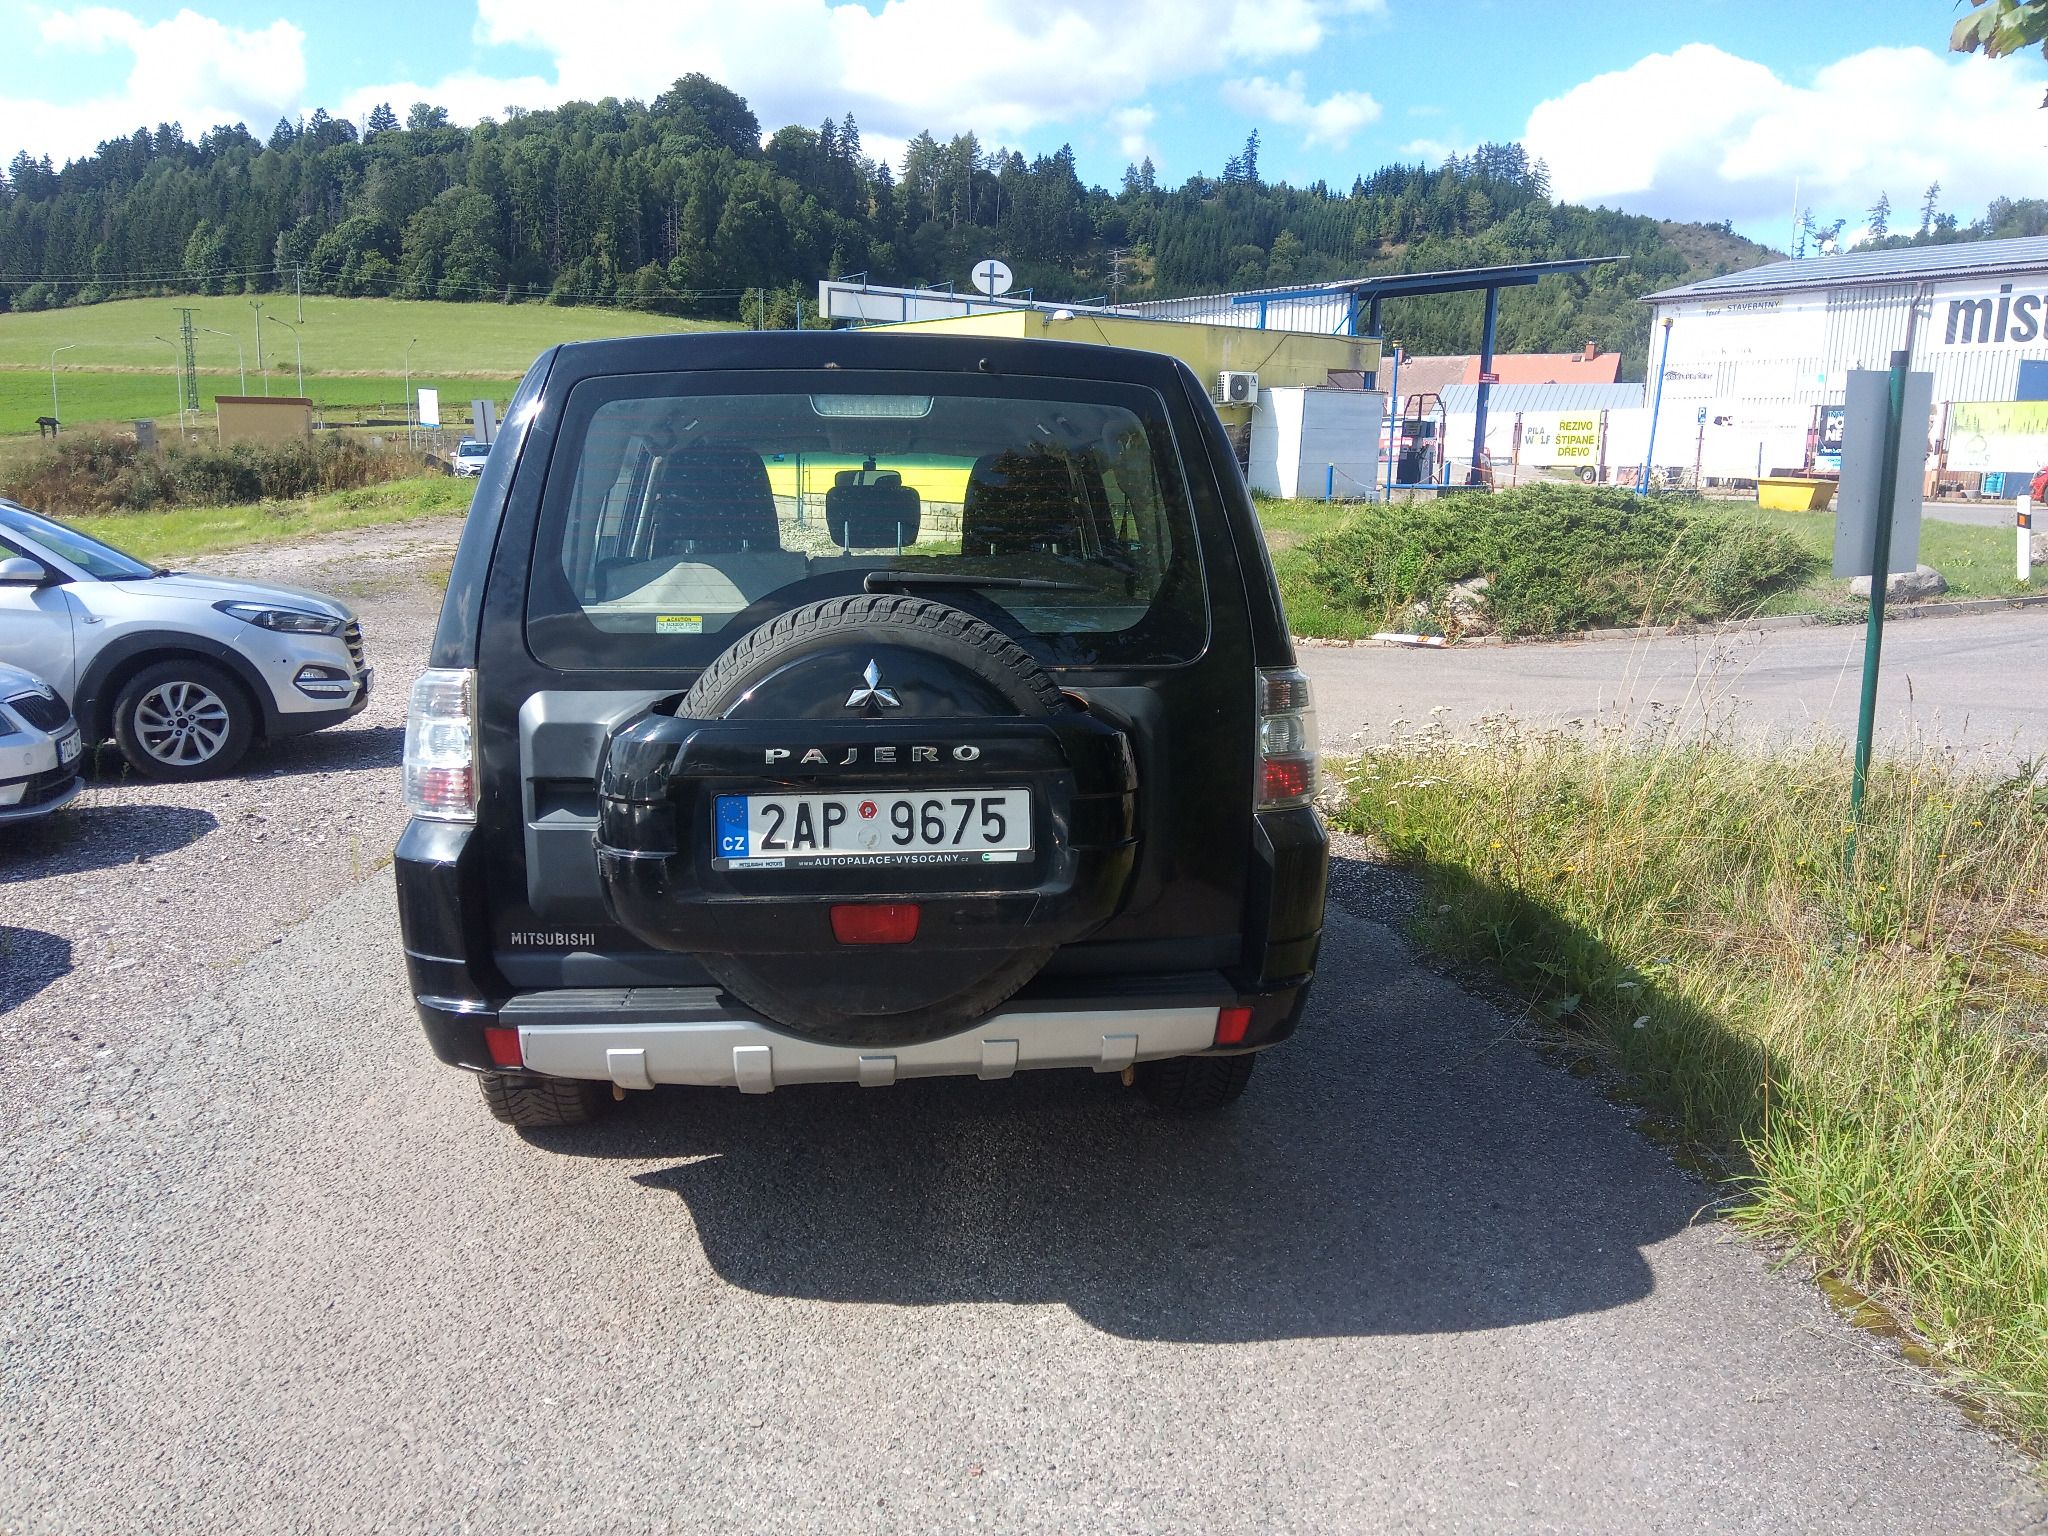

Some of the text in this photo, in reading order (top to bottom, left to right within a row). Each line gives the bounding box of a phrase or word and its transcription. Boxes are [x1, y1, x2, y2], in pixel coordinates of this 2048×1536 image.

[1524, 435, 1551, 445] WLF
[765, 744, 980, 765] PAJERO
[760, 797, 1006, 850] 2AP 9675
[722, 836, 745, 851] CZ
[511, 932, 595, 946] MITSUBISHI
